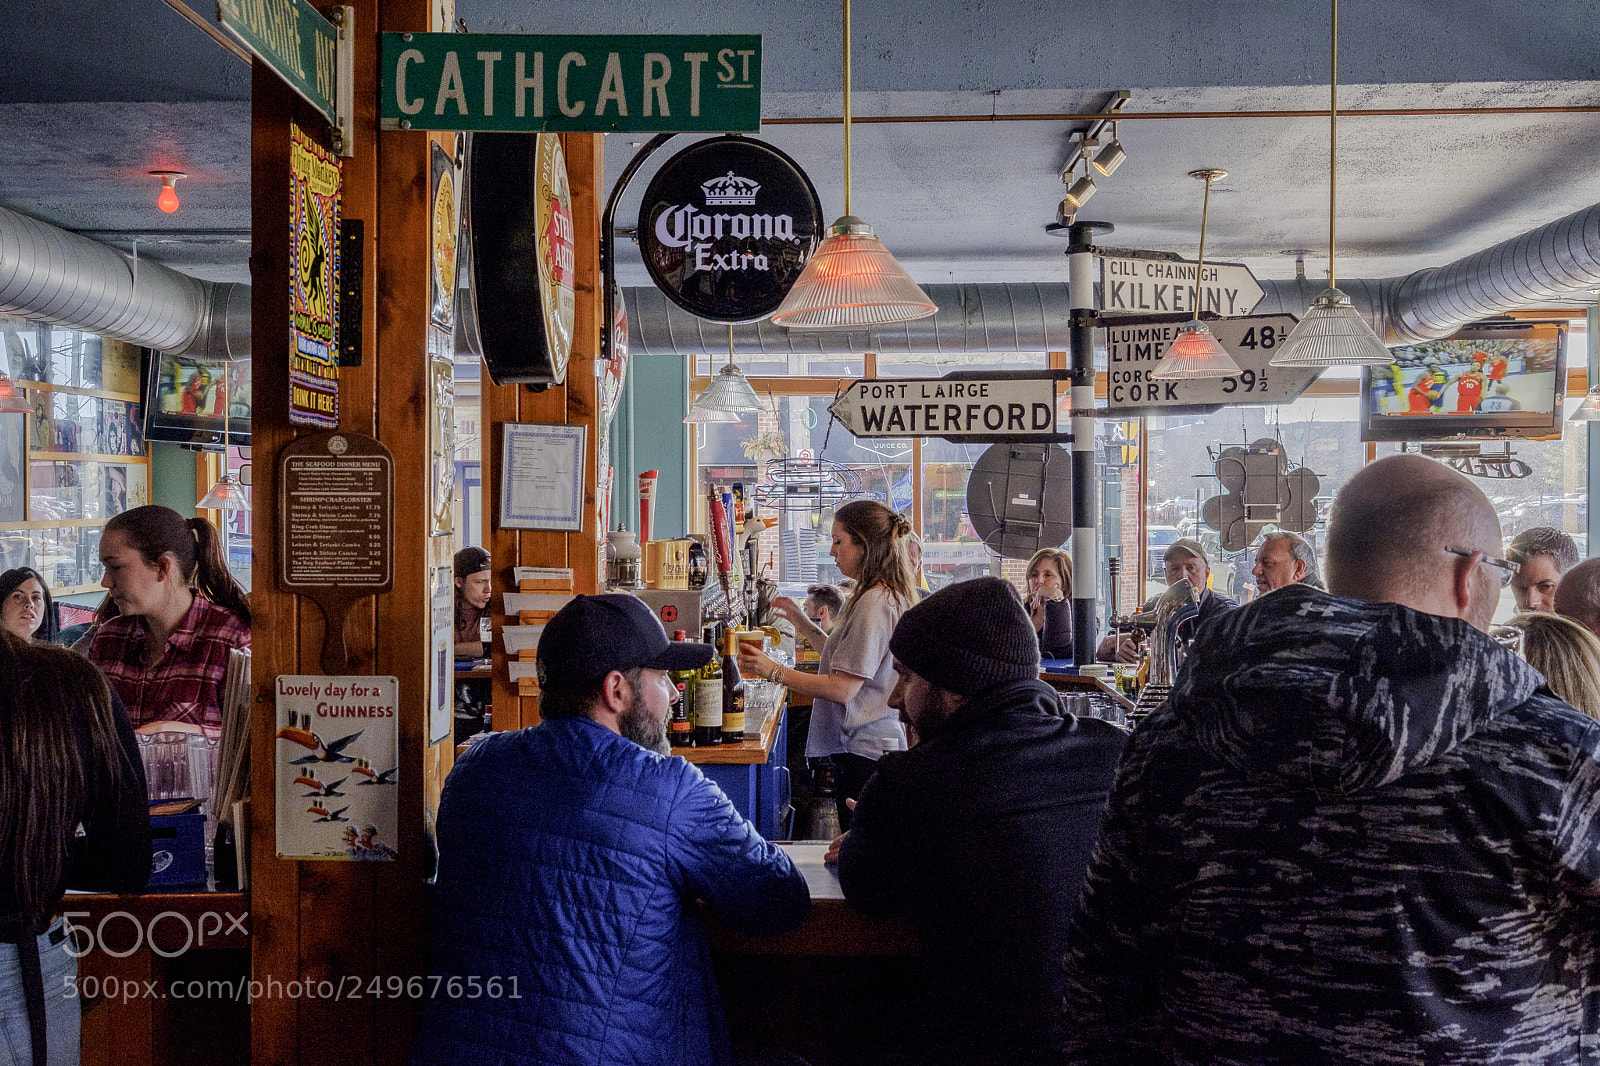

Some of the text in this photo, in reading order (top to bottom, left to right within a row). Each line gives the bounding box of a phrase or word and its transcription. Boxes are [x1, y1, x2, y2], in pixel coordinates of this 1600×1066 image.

[396, 48, 754, 117] CATHCART ST
[655, 203, 797, 252] Corona
[694, 243, 769, 271] Extra
[1110, 261, 1218, 282] CILL CHAINNGH
[1111, 280, 1238, 314] KILKENNY
[310, 391, 316, 409] IT
[317, 393, 334, 413] HERE
[860, 384, 908, 399] PORT
[1113, 382, 1179, 402] CORK
[860, 403, 1052, 431] WATERFORD
[279, 680, 381, 700] Lovely day for a
[317, 702, 394, 718] GUINNESS
